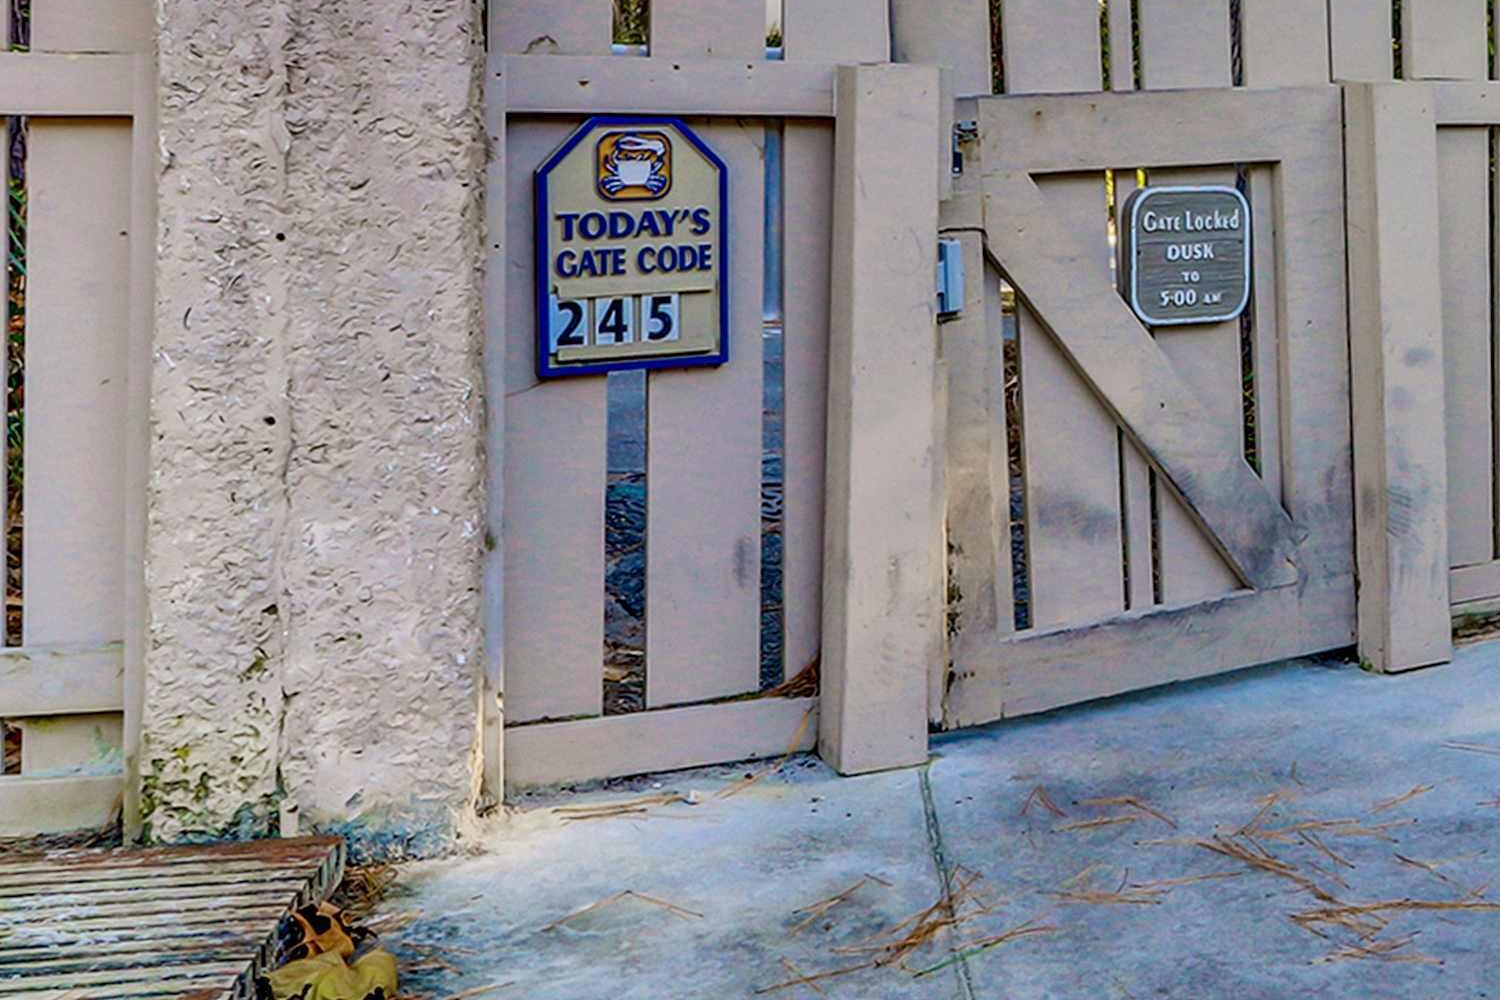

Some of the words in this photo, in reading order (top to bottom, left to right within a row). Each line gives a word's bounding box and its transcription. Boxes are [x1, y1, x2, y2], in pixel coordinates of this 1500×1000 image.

[555, 208, 711, 241] TODAY'S
[556, 248, 627, 279] GATE
[637, 244, 713, 274] CODE
[1167, 243, 1215, 261] DUSK
[1180, 270, 1201, 283] TO
[556, 295, 673, 346] 245
